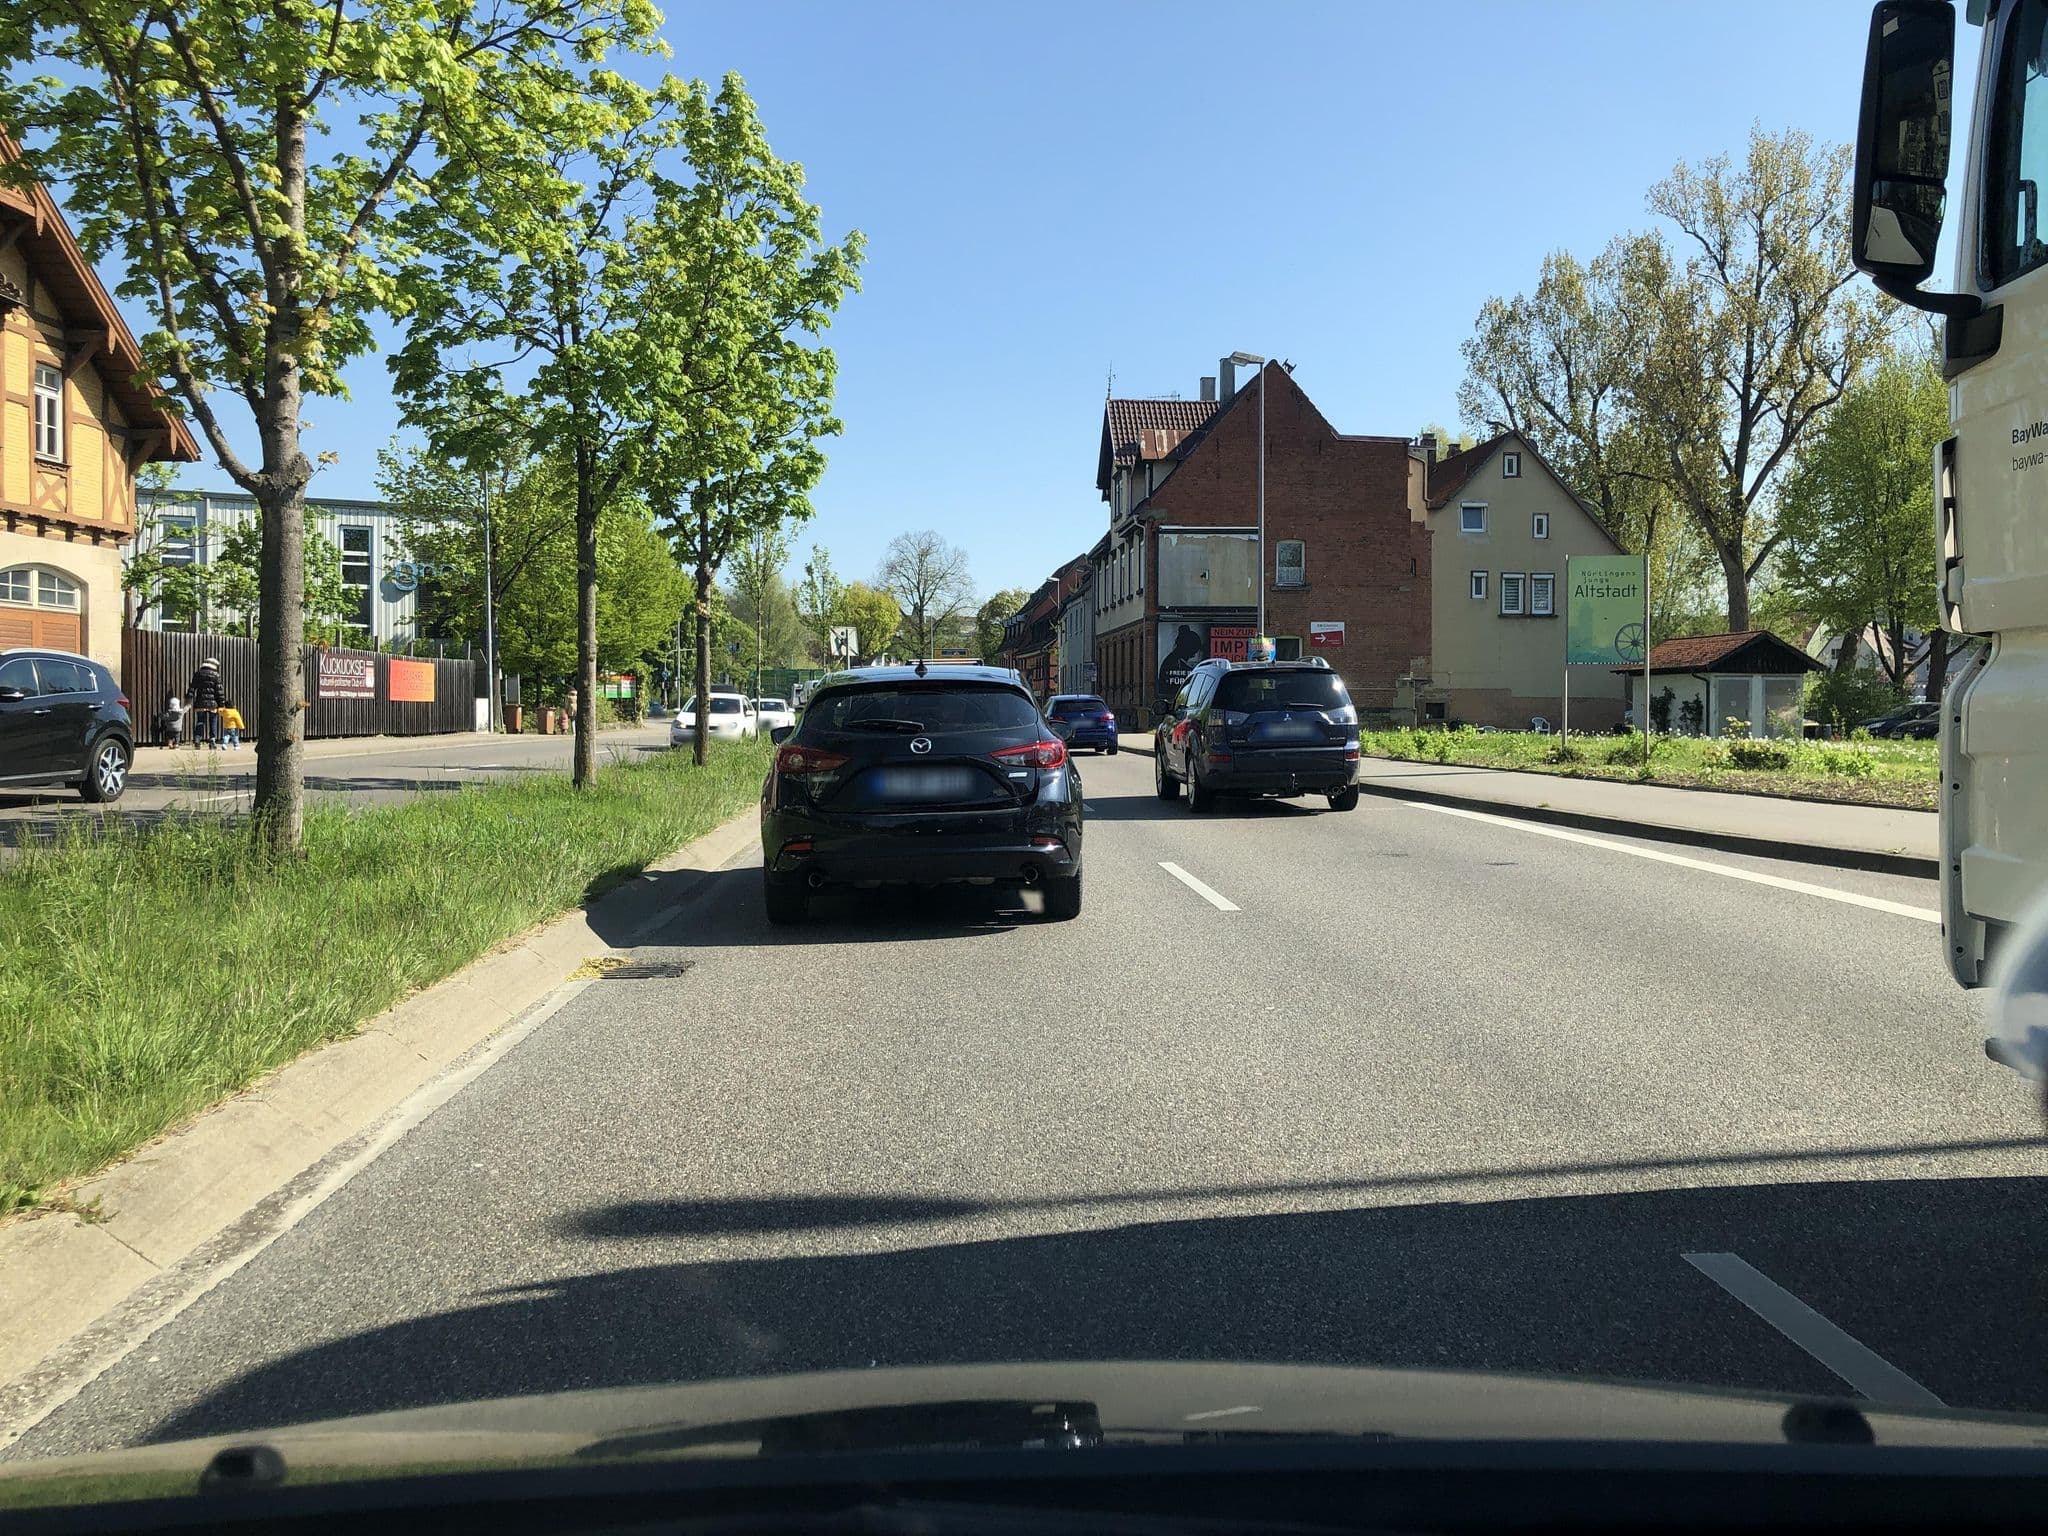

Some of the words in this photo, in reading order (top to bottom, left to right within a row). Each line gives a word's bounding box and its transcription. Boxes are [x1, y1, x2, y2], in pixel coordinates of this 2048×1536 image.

[2012, 421, 2048, 444] BayWa
[1574, 584, 1638, 598] Altstadt
[1214, 628, 1234, 636] NEIN
[1236, 628, 1254, 636] ZUR
[1214, 640, 1248, 654] IMP
[1169, 676, 1185, 685] FÜR
